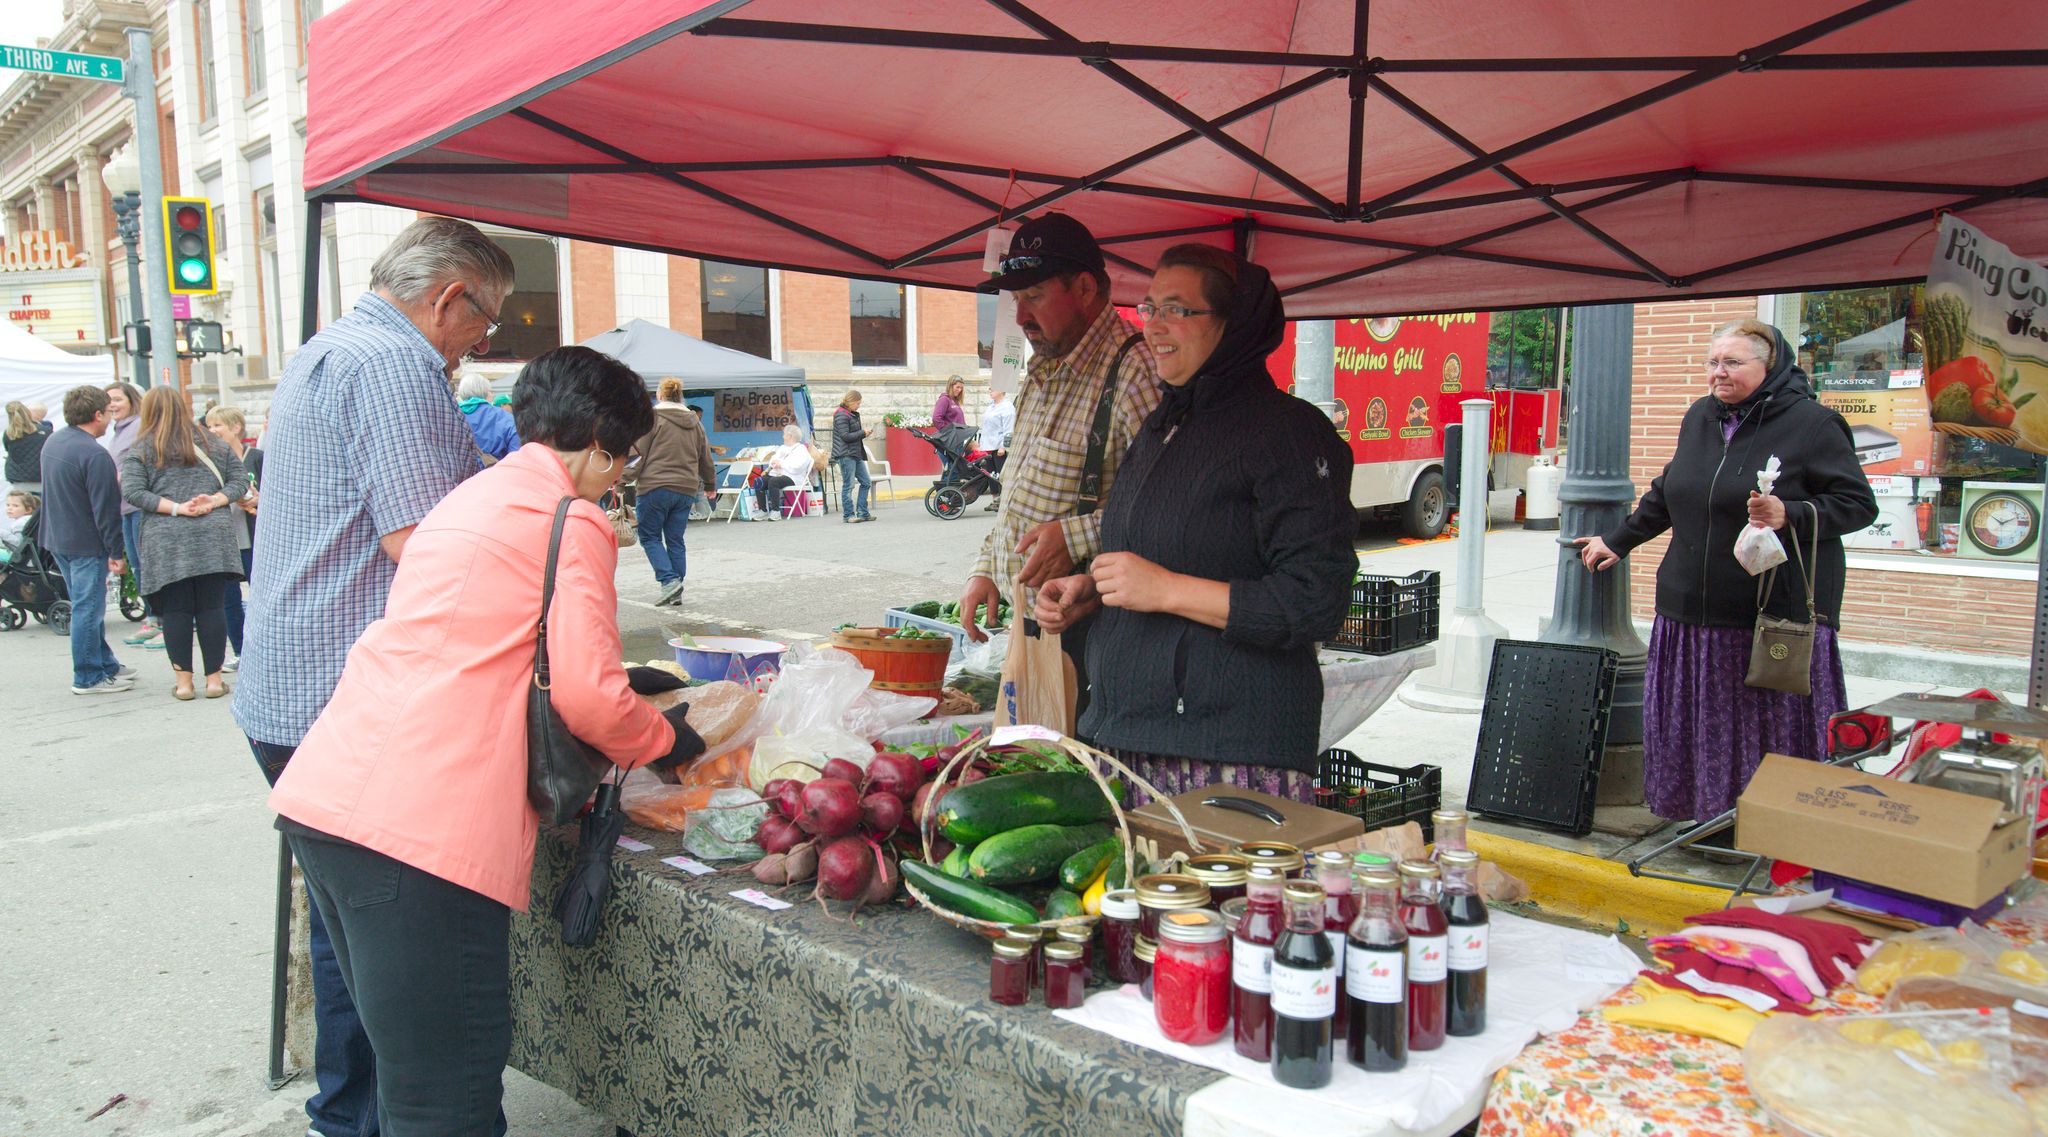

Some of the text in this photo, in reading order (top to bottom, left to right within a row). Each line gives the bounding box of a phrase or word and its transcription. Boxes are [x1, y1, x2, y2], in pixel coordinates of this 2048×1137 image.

[4, 47, 108, 77] THIRD AVE S
[0, 230, 90, 271] dith
[1944, 228, 2004, 297] King
[22, 295, 32, 305] IT
[9, 309, 51, 320] CHAPTER
[77, 329, 85, 340] R
[1003, 357, 1019, 365] OPEN
[1334, 346, 1425, 376] Filipino Grill
[723, 391, 789, 410] Fry Bread
[723, 413, 788, 429] Sold Here
[1868, 529, 1891, 537] ORCA
[1814, 787, 1848, 799] GLASS
[1879, 800, 1912, 813] VERRE
